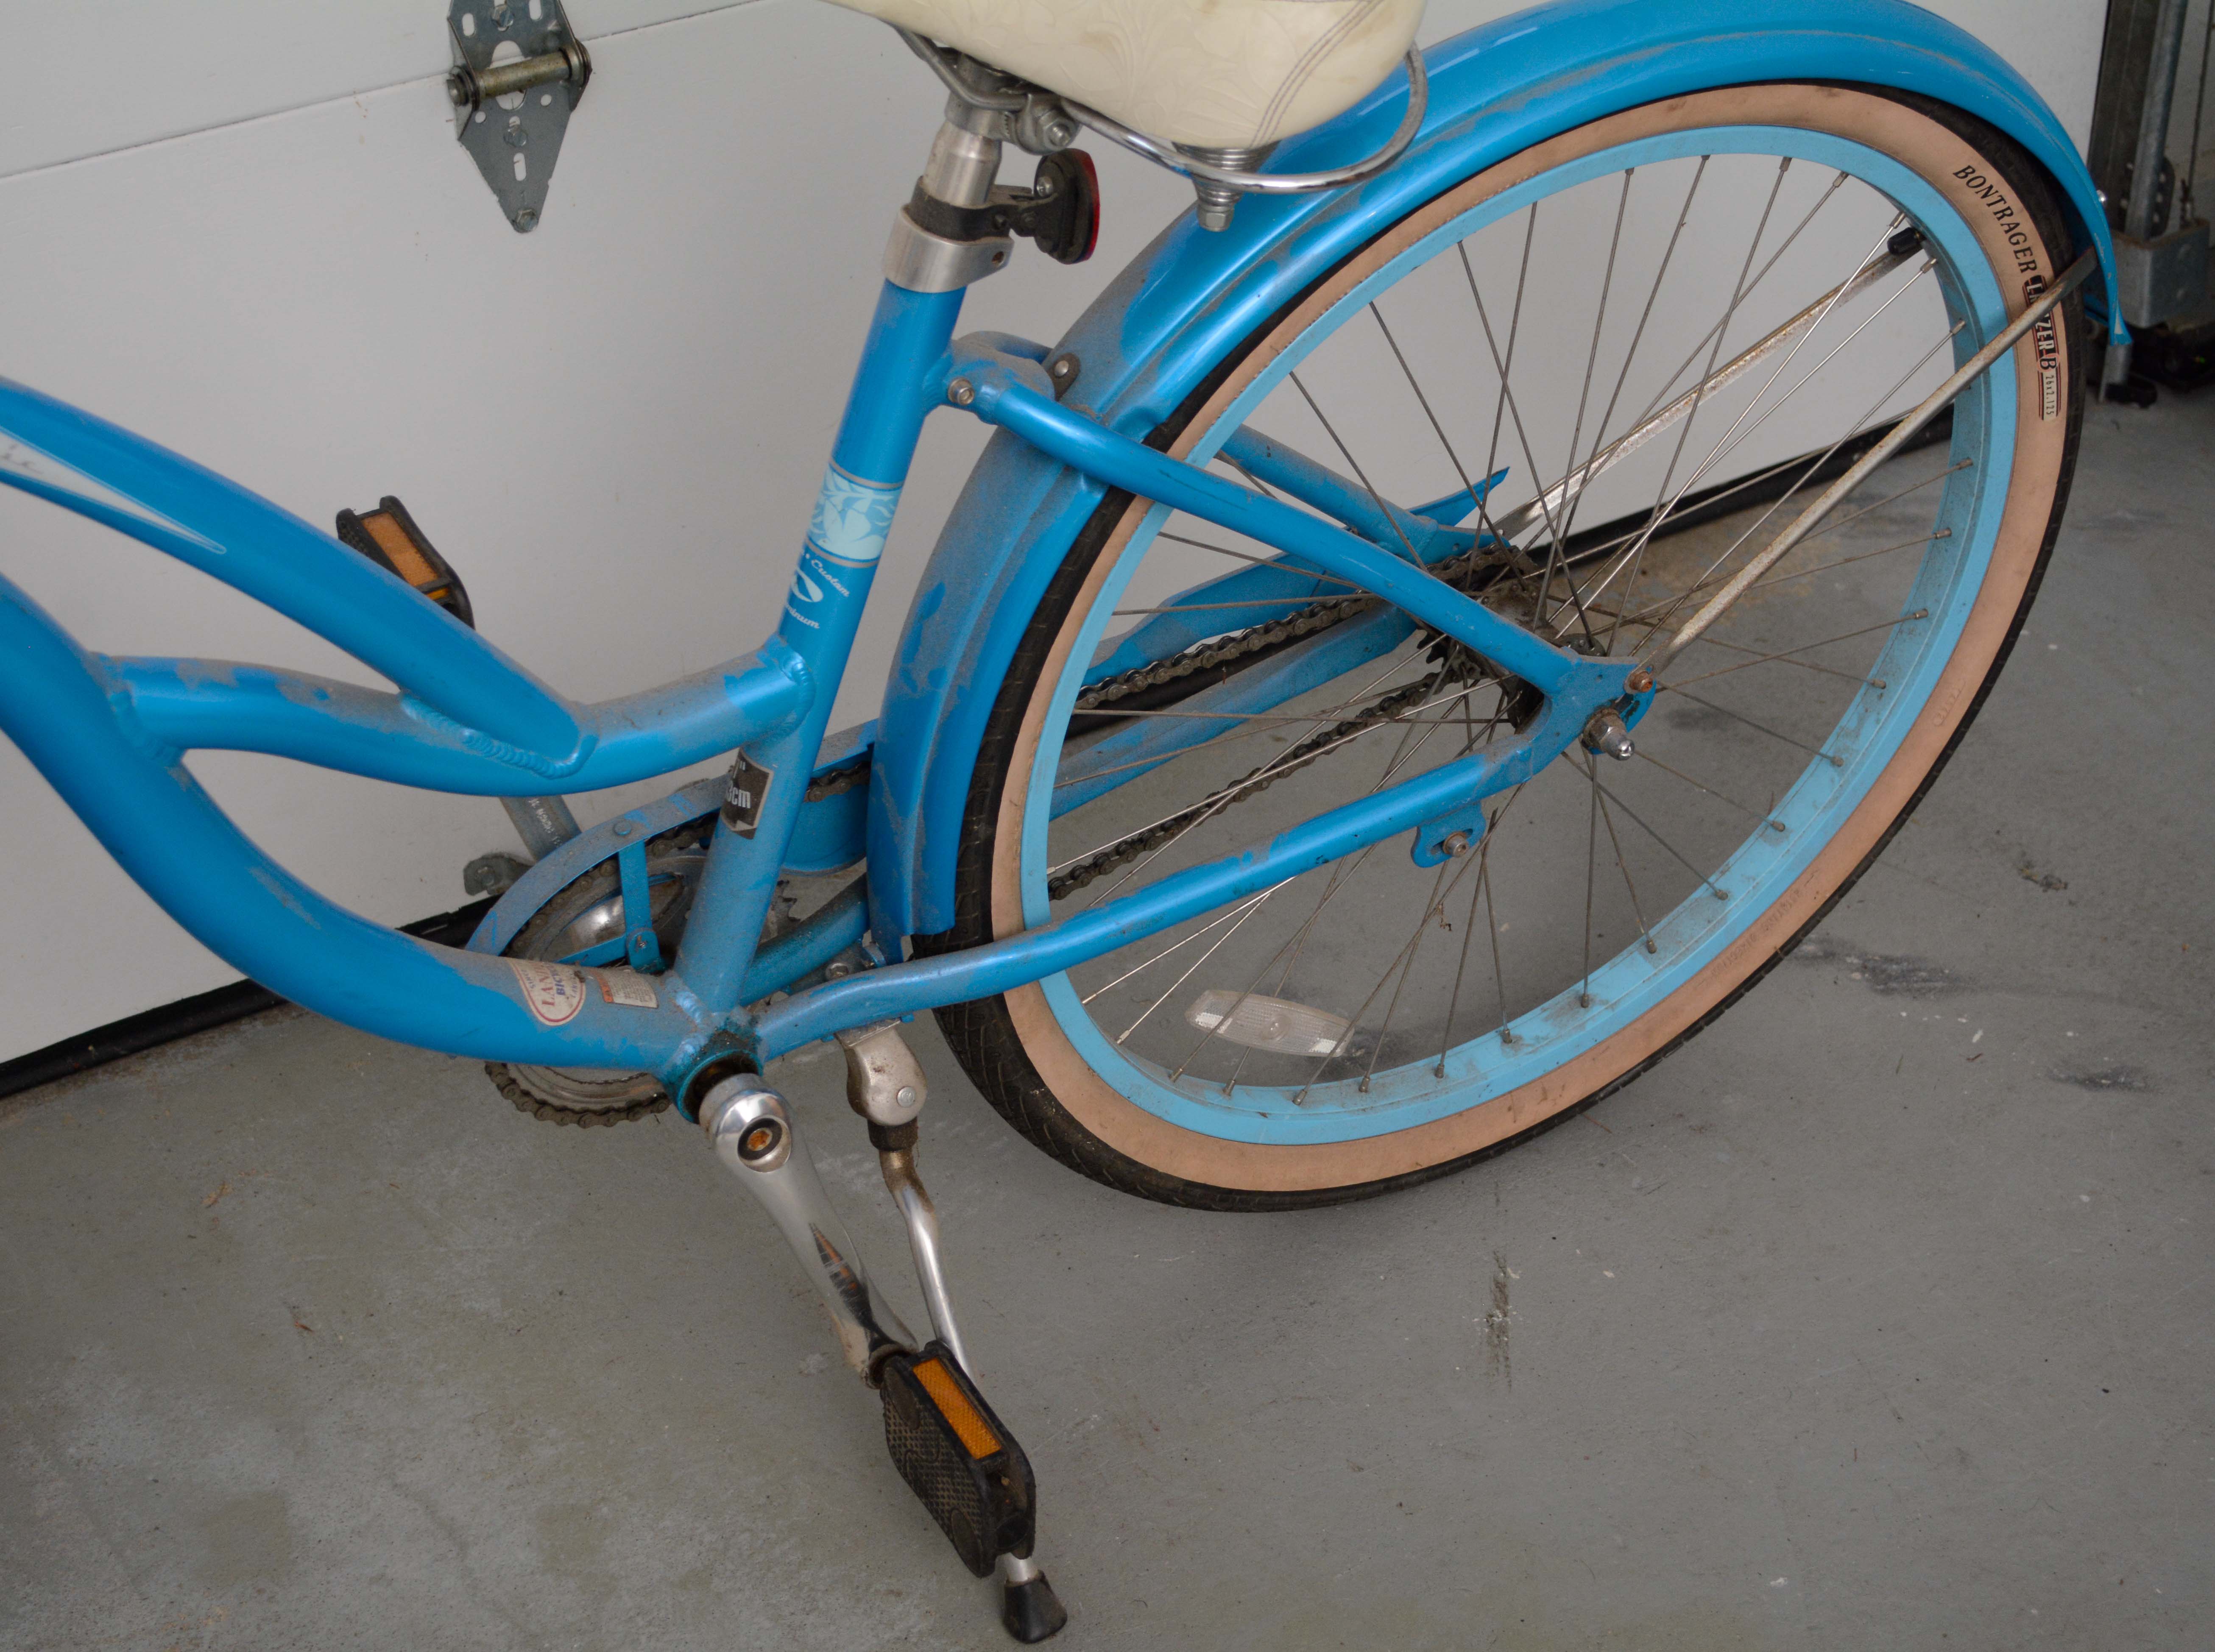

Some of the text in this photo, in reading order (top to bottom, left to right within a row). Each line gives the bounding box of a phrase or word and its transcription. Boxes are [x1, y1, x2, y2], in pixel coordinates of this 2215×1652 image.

[1953, 165, 2037, 273] BONTRAGER
[2026, 283, 2056, 370] CZER B
[2045, 375, 2054, 415] 26x2.125
[811, 559, 850, 597] Custom
